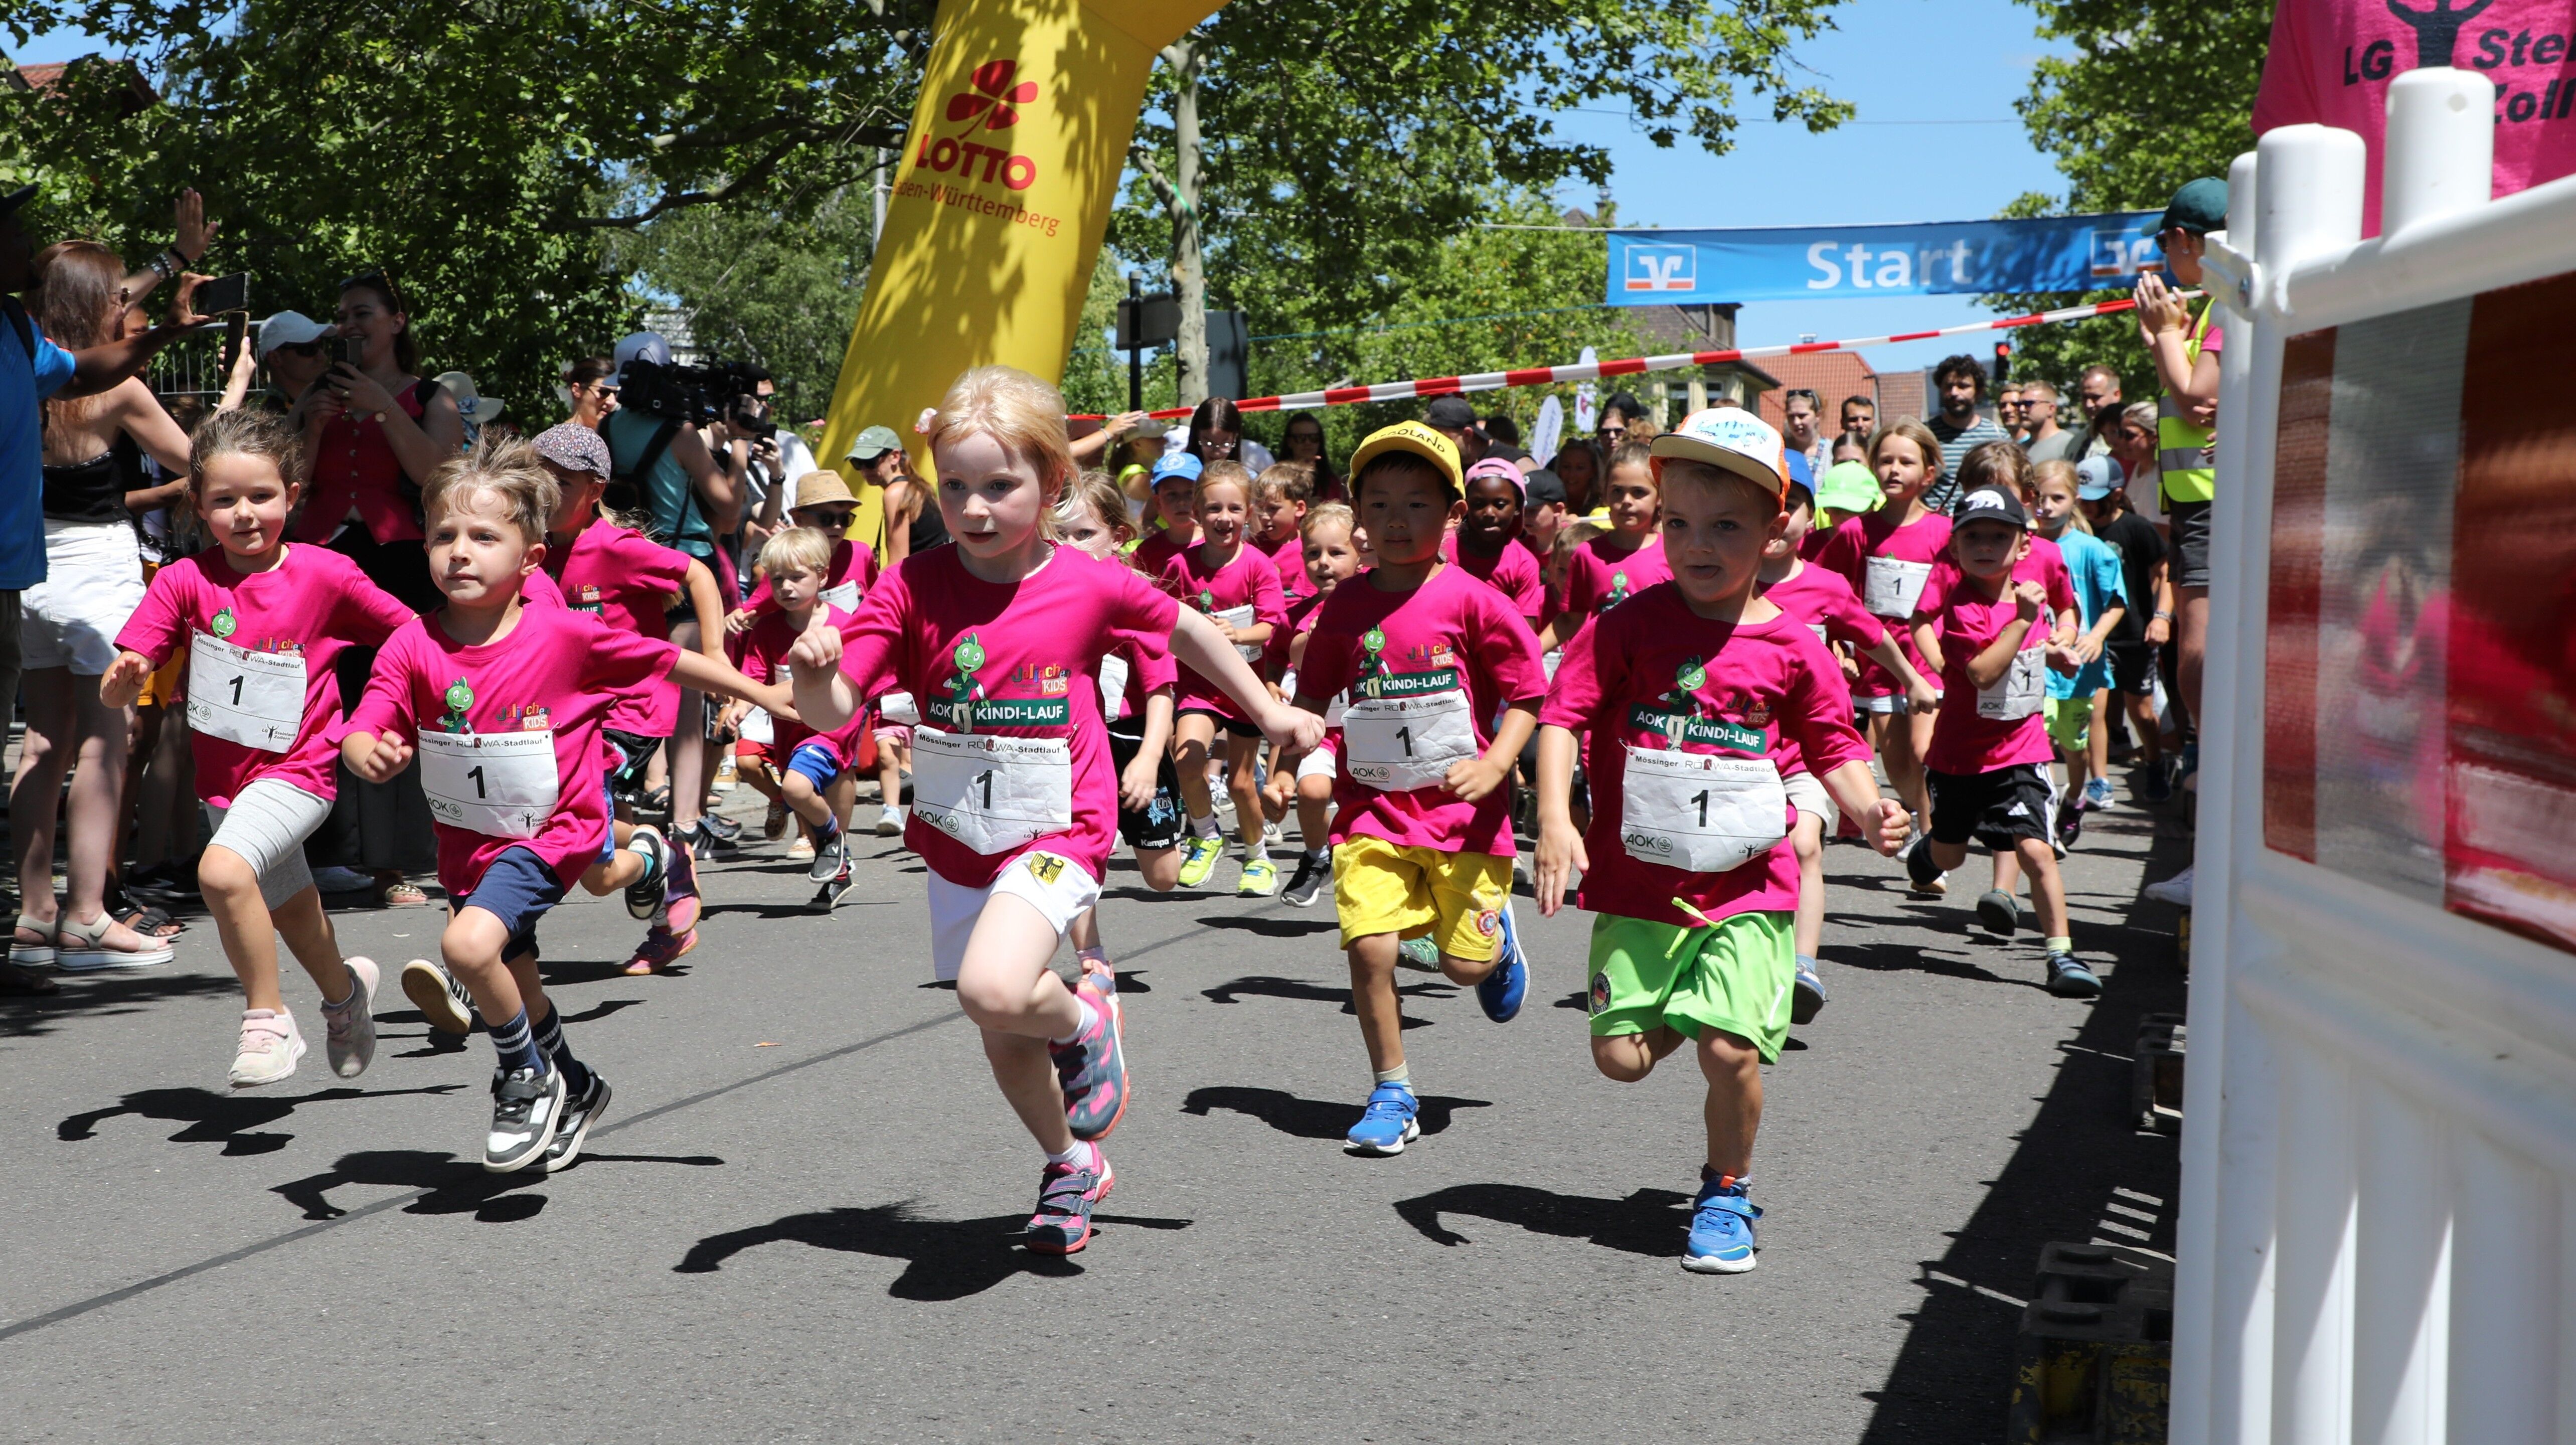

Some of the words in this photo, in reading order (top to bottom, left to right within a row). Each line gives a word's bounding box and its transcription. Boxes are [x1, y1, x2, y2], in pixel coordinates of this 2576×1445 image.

[2344, 40, 2394, 86] LG
[2472, 29, 2576, 70] Ste
[915, 134, 1036, 190] LOTTO
[1807, 240, 1975, 289] Start
[1893, 577, 1901, 595] 1
[582, 591, 600, 601] KIDS
[1432, 654, 1454, 668] KIDS
[1043, 678, 1067, 693] KIDS
[1383, 674, 1452, 691] KINDI-LAUF
[2023, 671, 2031, 691] 1
[229, 675, 244, 706] 1
[187, 701, 199, 715] OK
[930, 704, 951, 719] AOK
[976, 705, 1063, 721] KINDI-LAUF
[524, 716, 547, 730] KIDS
[1636, 711, 1666, 728] AOK
[1688, 723, 1759, 747] KINDI-LAUF
[919, 734, 961, 748] Mössinger
[1396, 726, 1412, 757] 1
[1636, 756, 1678, 767] Mössinger
[1352, 768, 1376, 777] AOK
[467, 766, 486, 798] 1
[977, 770, 993, 809] 1
[1691, 789, 1709, 827] 1
[918, 810, 943, 828] AOK
[1141, 838, 1170, 848] Kempa
[1626, 834, 1656, 849] AOK
